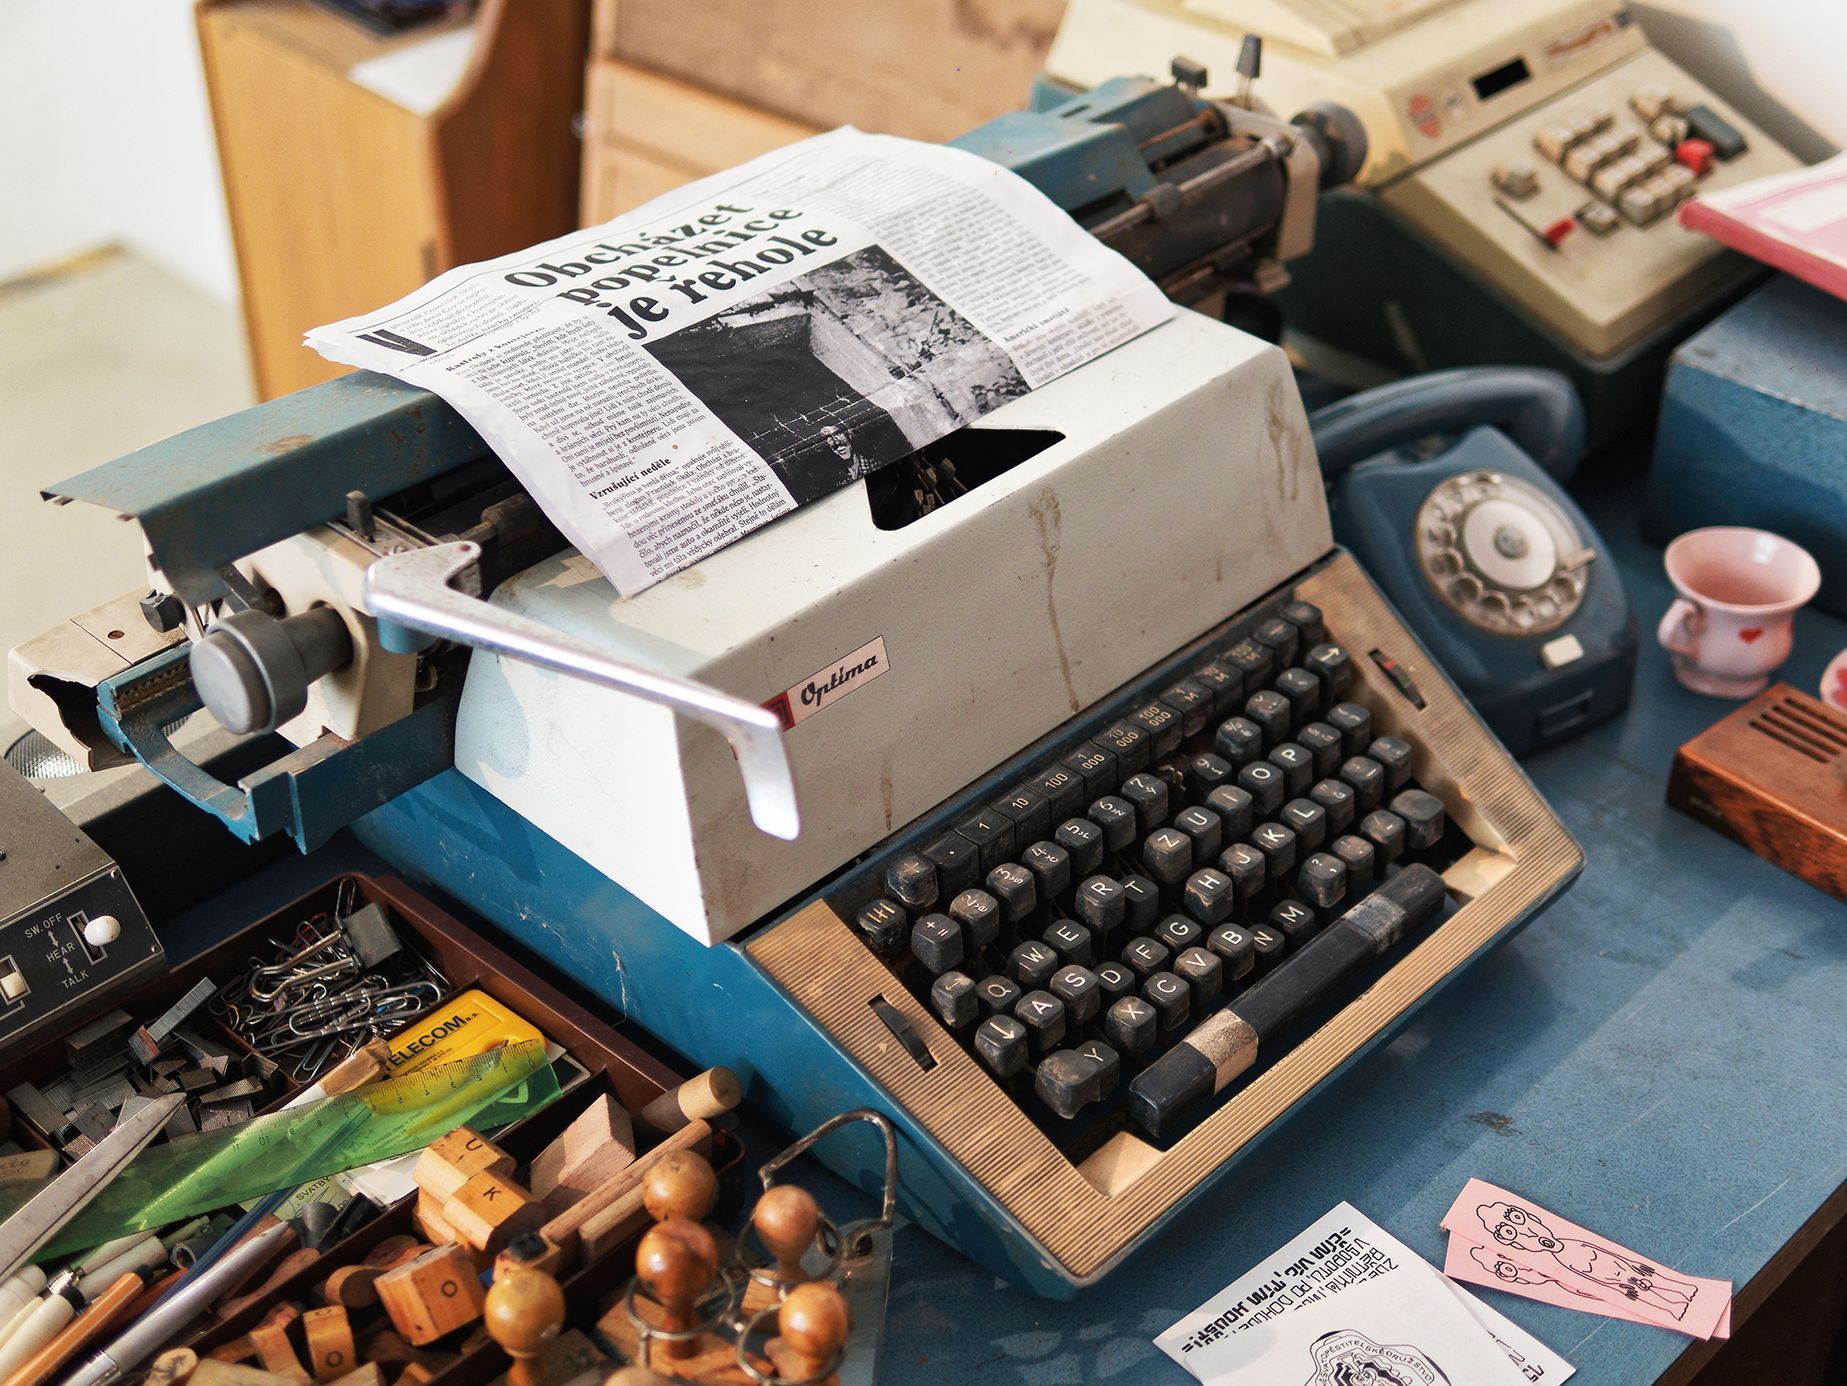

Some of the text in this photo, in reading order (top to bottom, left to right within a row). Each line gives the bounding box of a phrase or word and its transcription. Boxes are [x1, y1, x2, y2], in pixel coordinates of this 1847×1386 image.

[504, 203, 754, 288] Obcházet
[557, 209, 803, 305] popelnice
[596, 296, 669, 340] je
[656, 229, 838, 304] řehole
[589, 459, 669, 498] Vzrušující neděle
[800, 655, 879, 707] Optima
[1139, 706, 1160, 720] 100
[1148, 711, 1172, 727] 000
[1116, 731, 1139, 747] 000
[1081, 754, 1105, 770] 000
[1280, 748, 1297, 762] P
[1045, 773, 1068, 789] 100
[1251, 767, 1271, 780] O
[1013, 797, 1029, 809] 10
[1187, 812, 1207, 826] U
[1292, 808, 1315, 819] L
[1157, 834, 1180, 847] Z
[1262, 828, 1286, 843] K
[1236, 851, 1251, 864] J
[1090, 881, 1113, 896] R
[1125, 880, 1144, 894] T
[1198, 875, 1221, 890] H
[1280, 905, 1304, 923] M
[1056, 925, 1079, 942] E
[1169, 921, 1189, 936] G
[1221, 930, 1242, 945] B
[1253, 931, 1274, 946] N
[46, 942, 76, 963] HEAR
[1021, 947, 1045, 963] W
[1135, 944, 1152, 960] F
[1186, 953, 1207, 967] V
[61, 970, 90, 989] TALK
[1064, 972, 1086, 988] S
[1100, 969, 1122, 984] D
[987, 984, 1012, 998] Q
[1156, 979, 1177, 994] C
[1031, 1000, 1053, 1015] A
[1120, 1004, 1144, 1020] X
[1083, 1047, 1104, 1062] Y
[465, 1138, 483, 1151] U
[295, 1175, 331, 1201] SVATBY
[483, 1186, 502, 1201] K
[1291, 1280, 1312, 1297] PO
